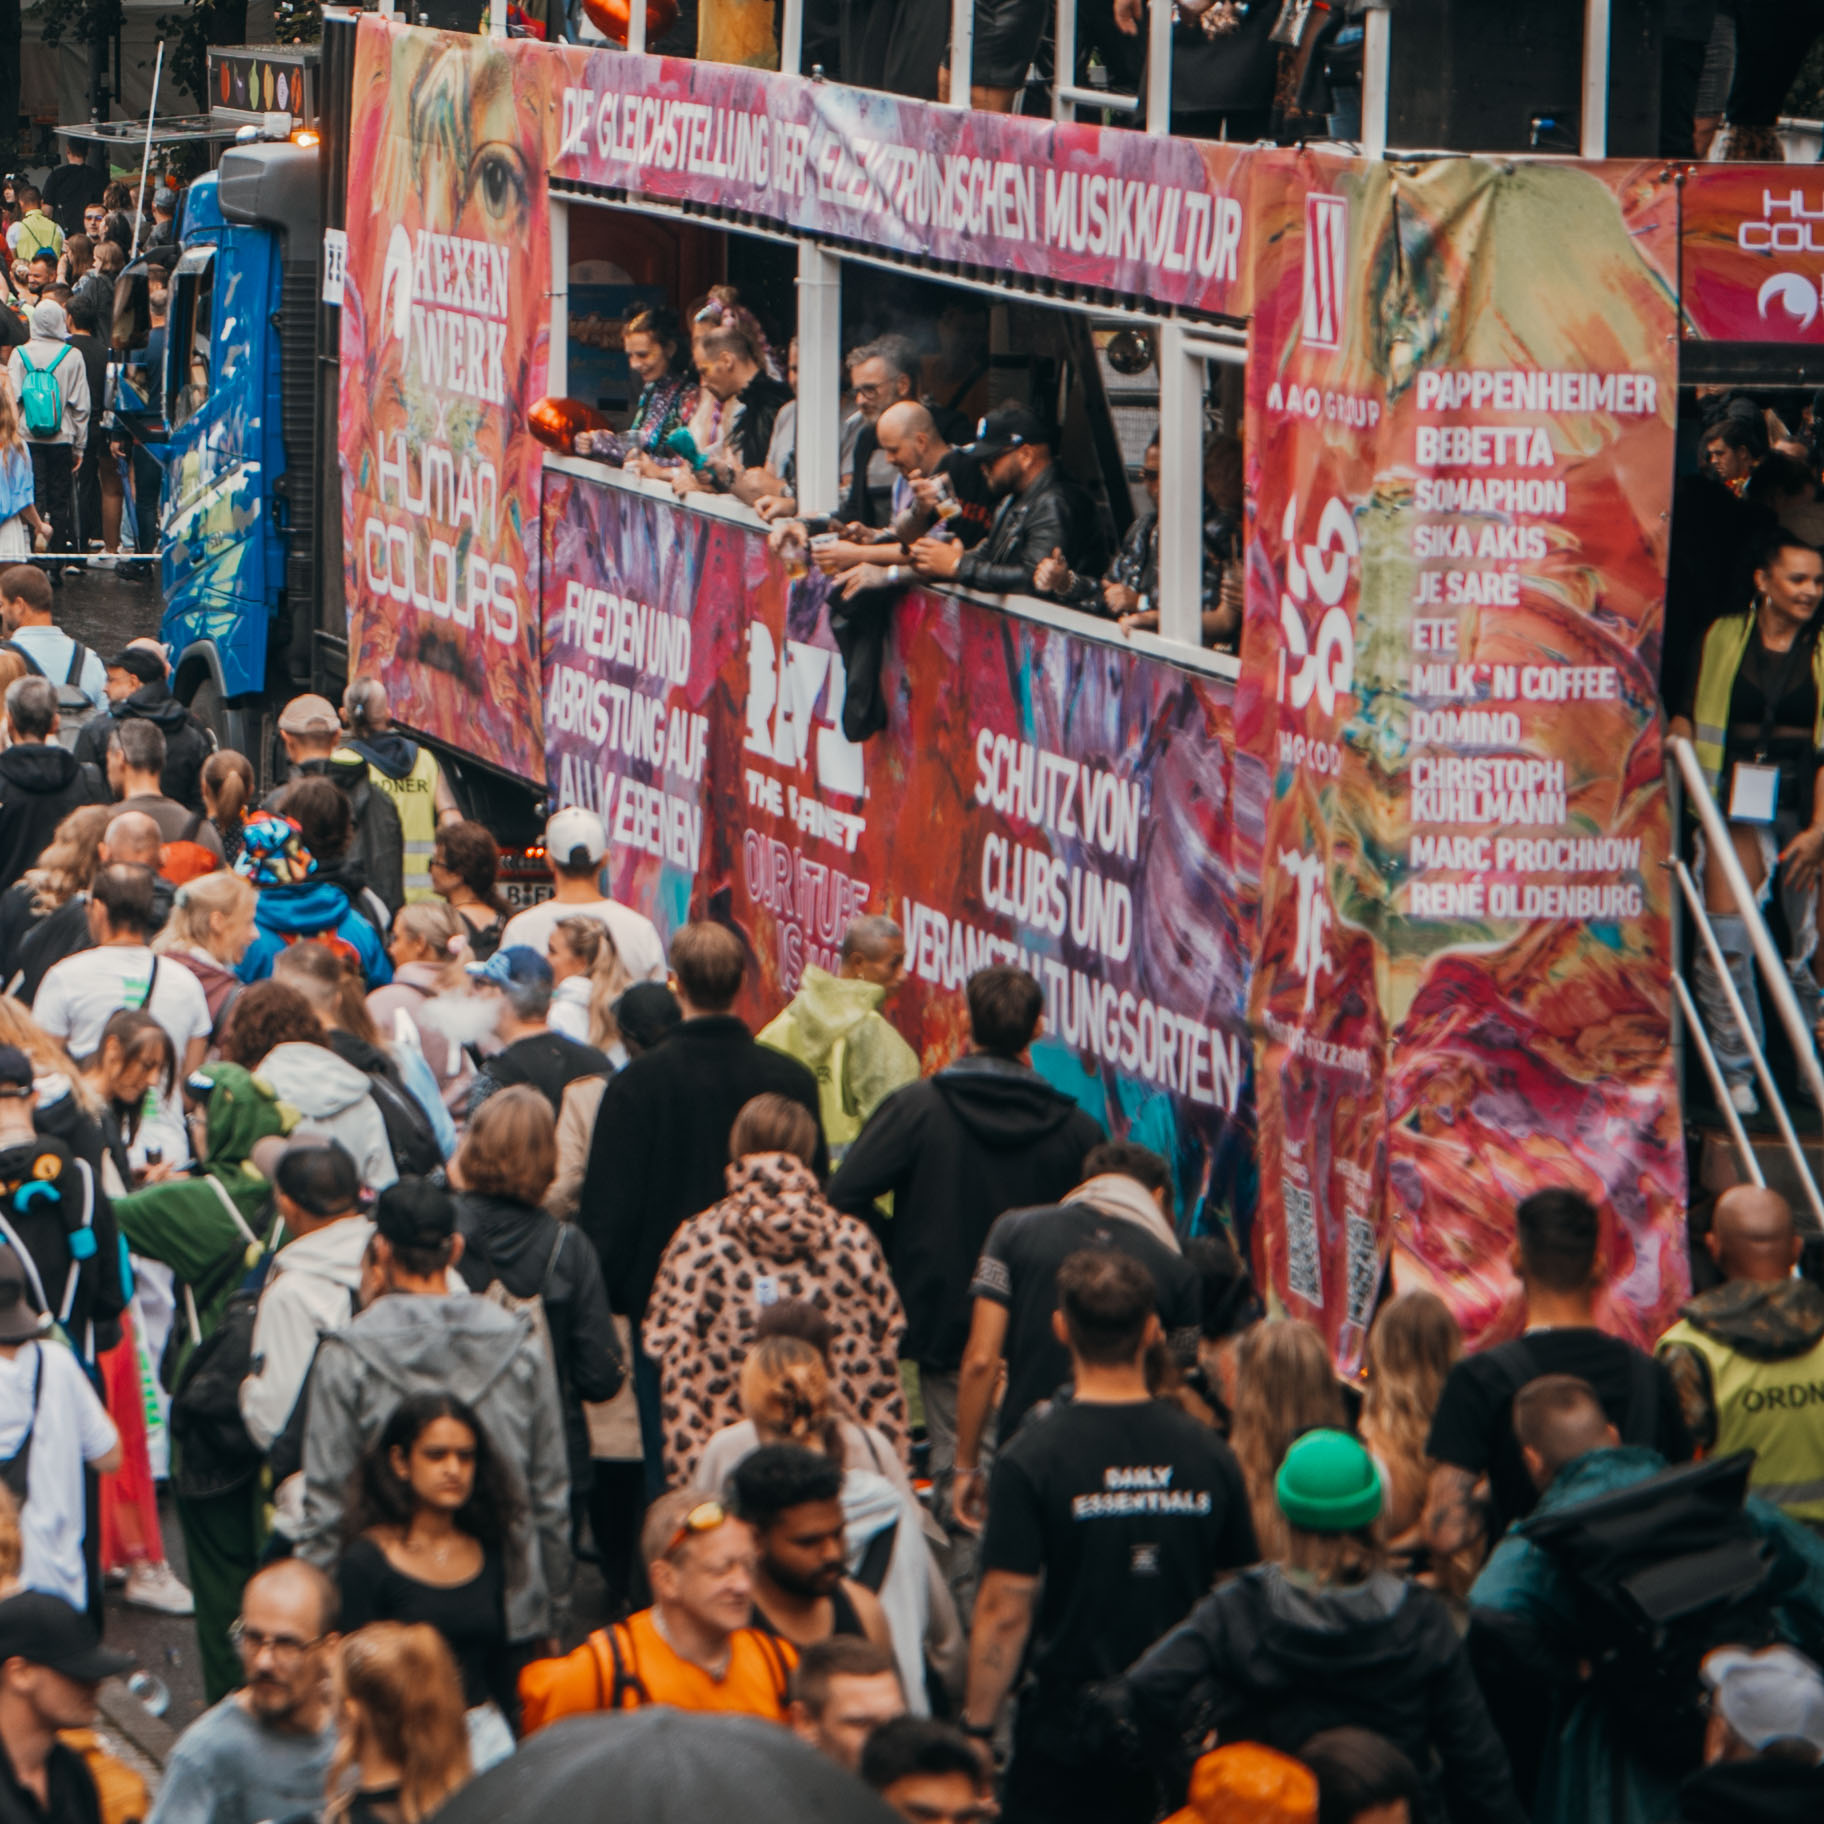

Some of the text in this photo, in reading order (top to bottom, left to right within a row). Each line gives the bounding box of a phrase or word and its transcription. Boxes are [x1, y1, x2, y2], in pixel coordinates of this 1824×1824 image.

[596, 90, 770, 187] GLEICHSTELLUNG
[772, 119, 809, 197] DER
[412, 228, 510, 321] HEXEN
[412, 304, 508, 405] WERK
[1415, 370, 1656, 414] PAPPENHEIMER
[1415, 426, 1555, 467] BEBETTA
[378, 429, 497, 542] HUMAN
[1414, 478, 1566, 515] SOMAPHON
[1414, 526, 1547, 559] SIKA AKIS
[1413, 563, 1520, 606] JE SARÉ
[647, 607, 692, 687] UND
[1412, 619, 1458, 652] ETE
[1411, 666, 1475, 698] MILK
[1520, 666, 1617, 701] COFFEE
[665, 706, 709, 783] AUF
[1411, 710, 1520, 745] DOMINO
[745, 768, 785, 818] THE
[974, 727, 1141, 861] SCHUTZ VON
[1411, 757, 1565, 793] CHRISTOPH
[613, 776, 703, 873] EBENEN
[1411, 791, 1567, 825] KUHLMANN
[1411, 835, 1641, 872] MARC PROCHNOW
[981, 832, 1133, 963] CLUBS UND
[1410, 876, 1642, 919] RENÉ OLDENBURG
[1104, 1466, 1173, 1489] DAILY
[1072, 1491, 1211, 1521] ESSENTIALS
